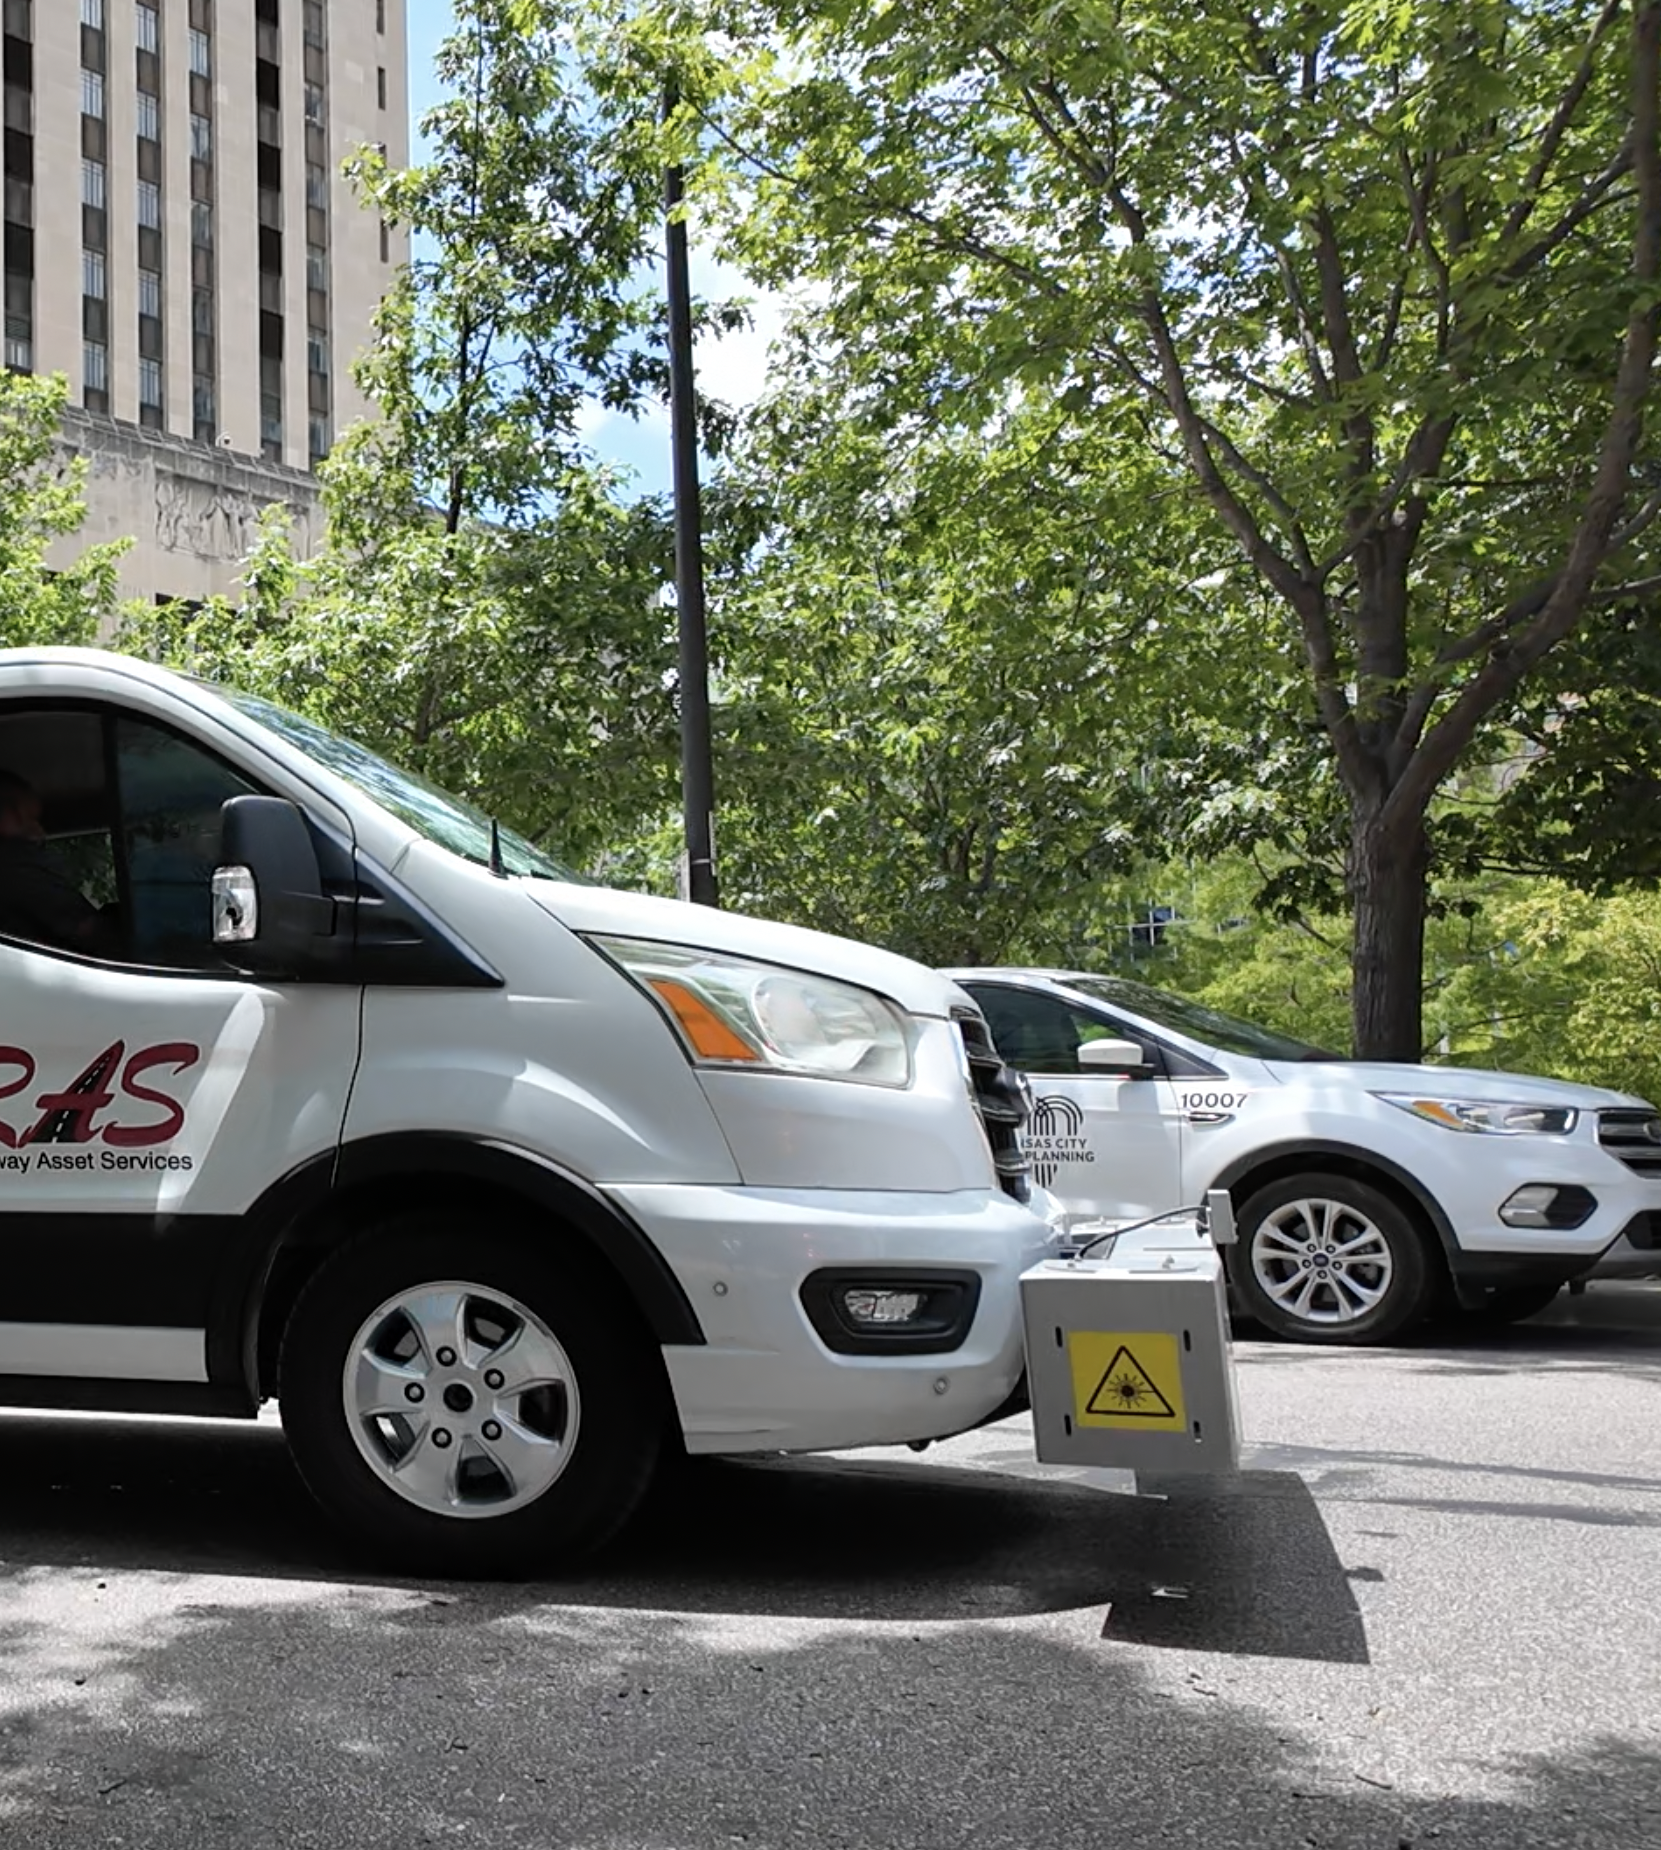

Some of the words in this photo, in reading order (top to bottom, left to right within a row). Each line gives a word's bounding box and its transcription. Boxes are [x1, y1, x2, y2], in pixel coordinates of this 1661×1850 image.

[1181, 1092, 1248, 1108] 10007
[1055, 1138, 1087, 1149] CITY
[37, 1151, 94, 1170] Asset
[101, 1151, 193, 1170] Services
[1025, 1151, 1095, 1163] PLANNING
